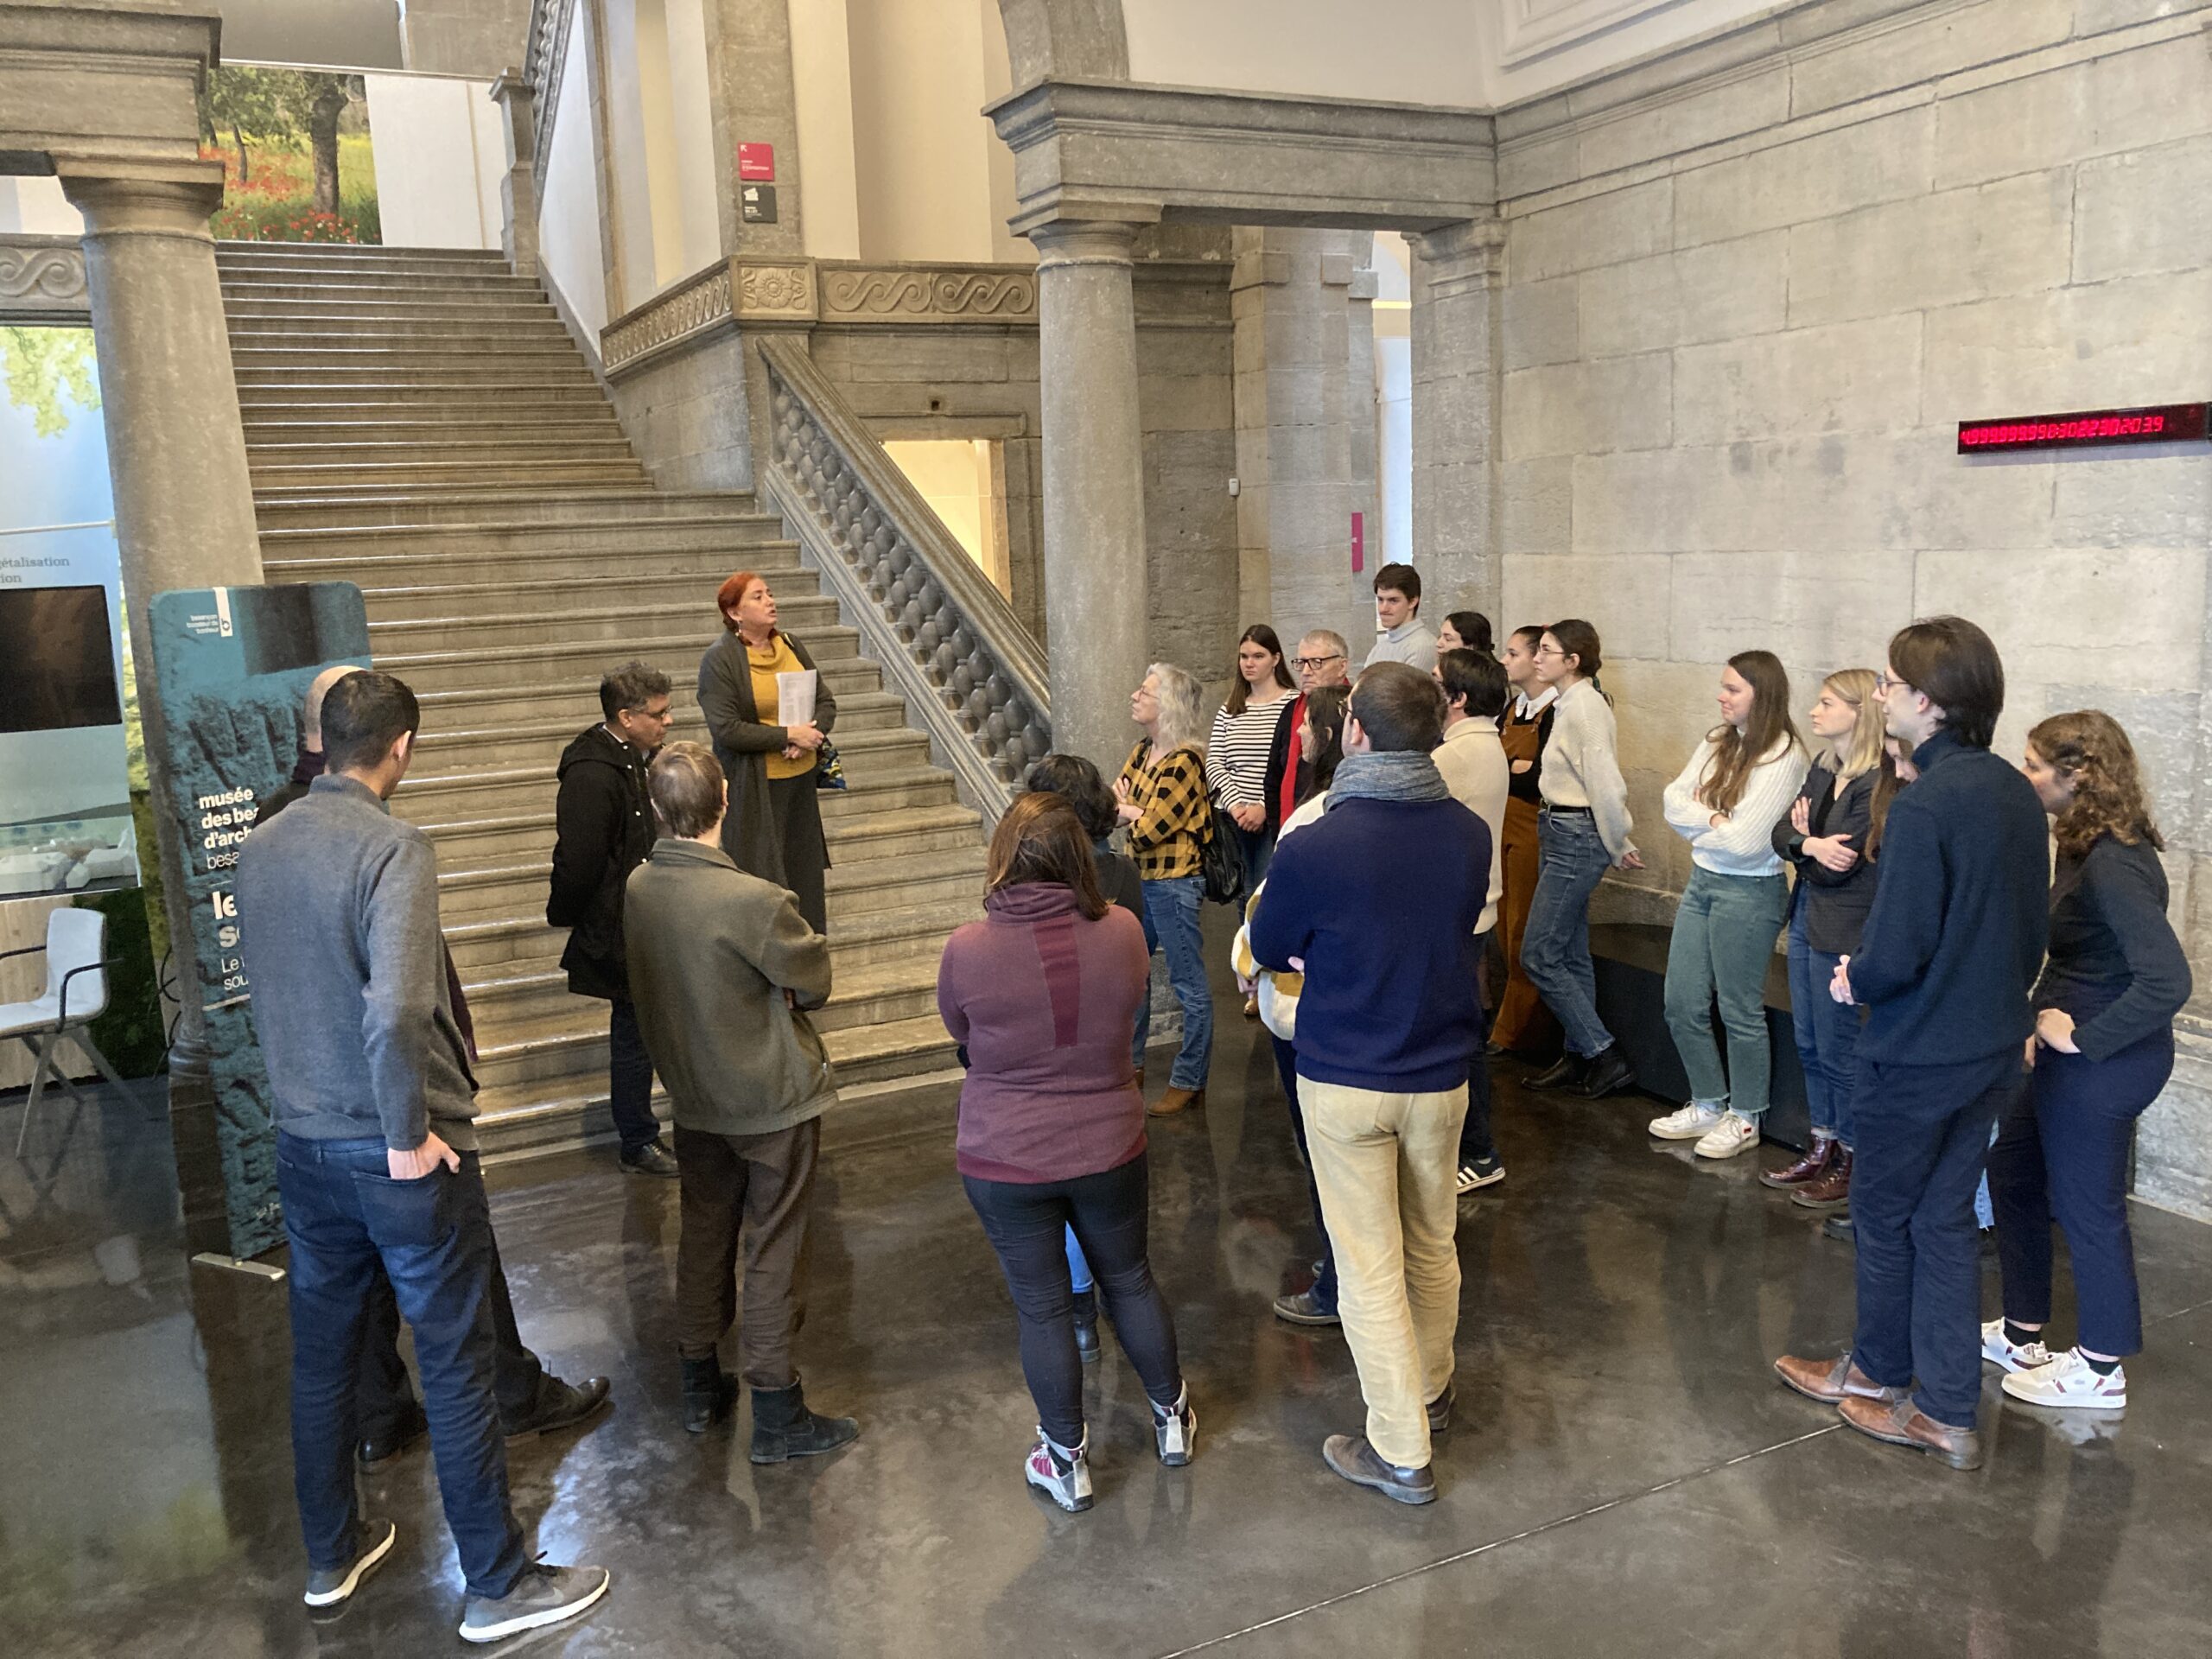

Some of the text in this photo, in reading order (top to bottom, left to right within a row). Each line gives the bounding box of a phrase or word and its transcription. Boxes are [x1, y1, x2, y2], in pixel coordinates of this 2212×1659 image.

[0, 557, 69, 570] étalisation
[199, 786, 253, 809] musée
[201, 812, 232, 830] des
[221, 958, 239, 973] Le
